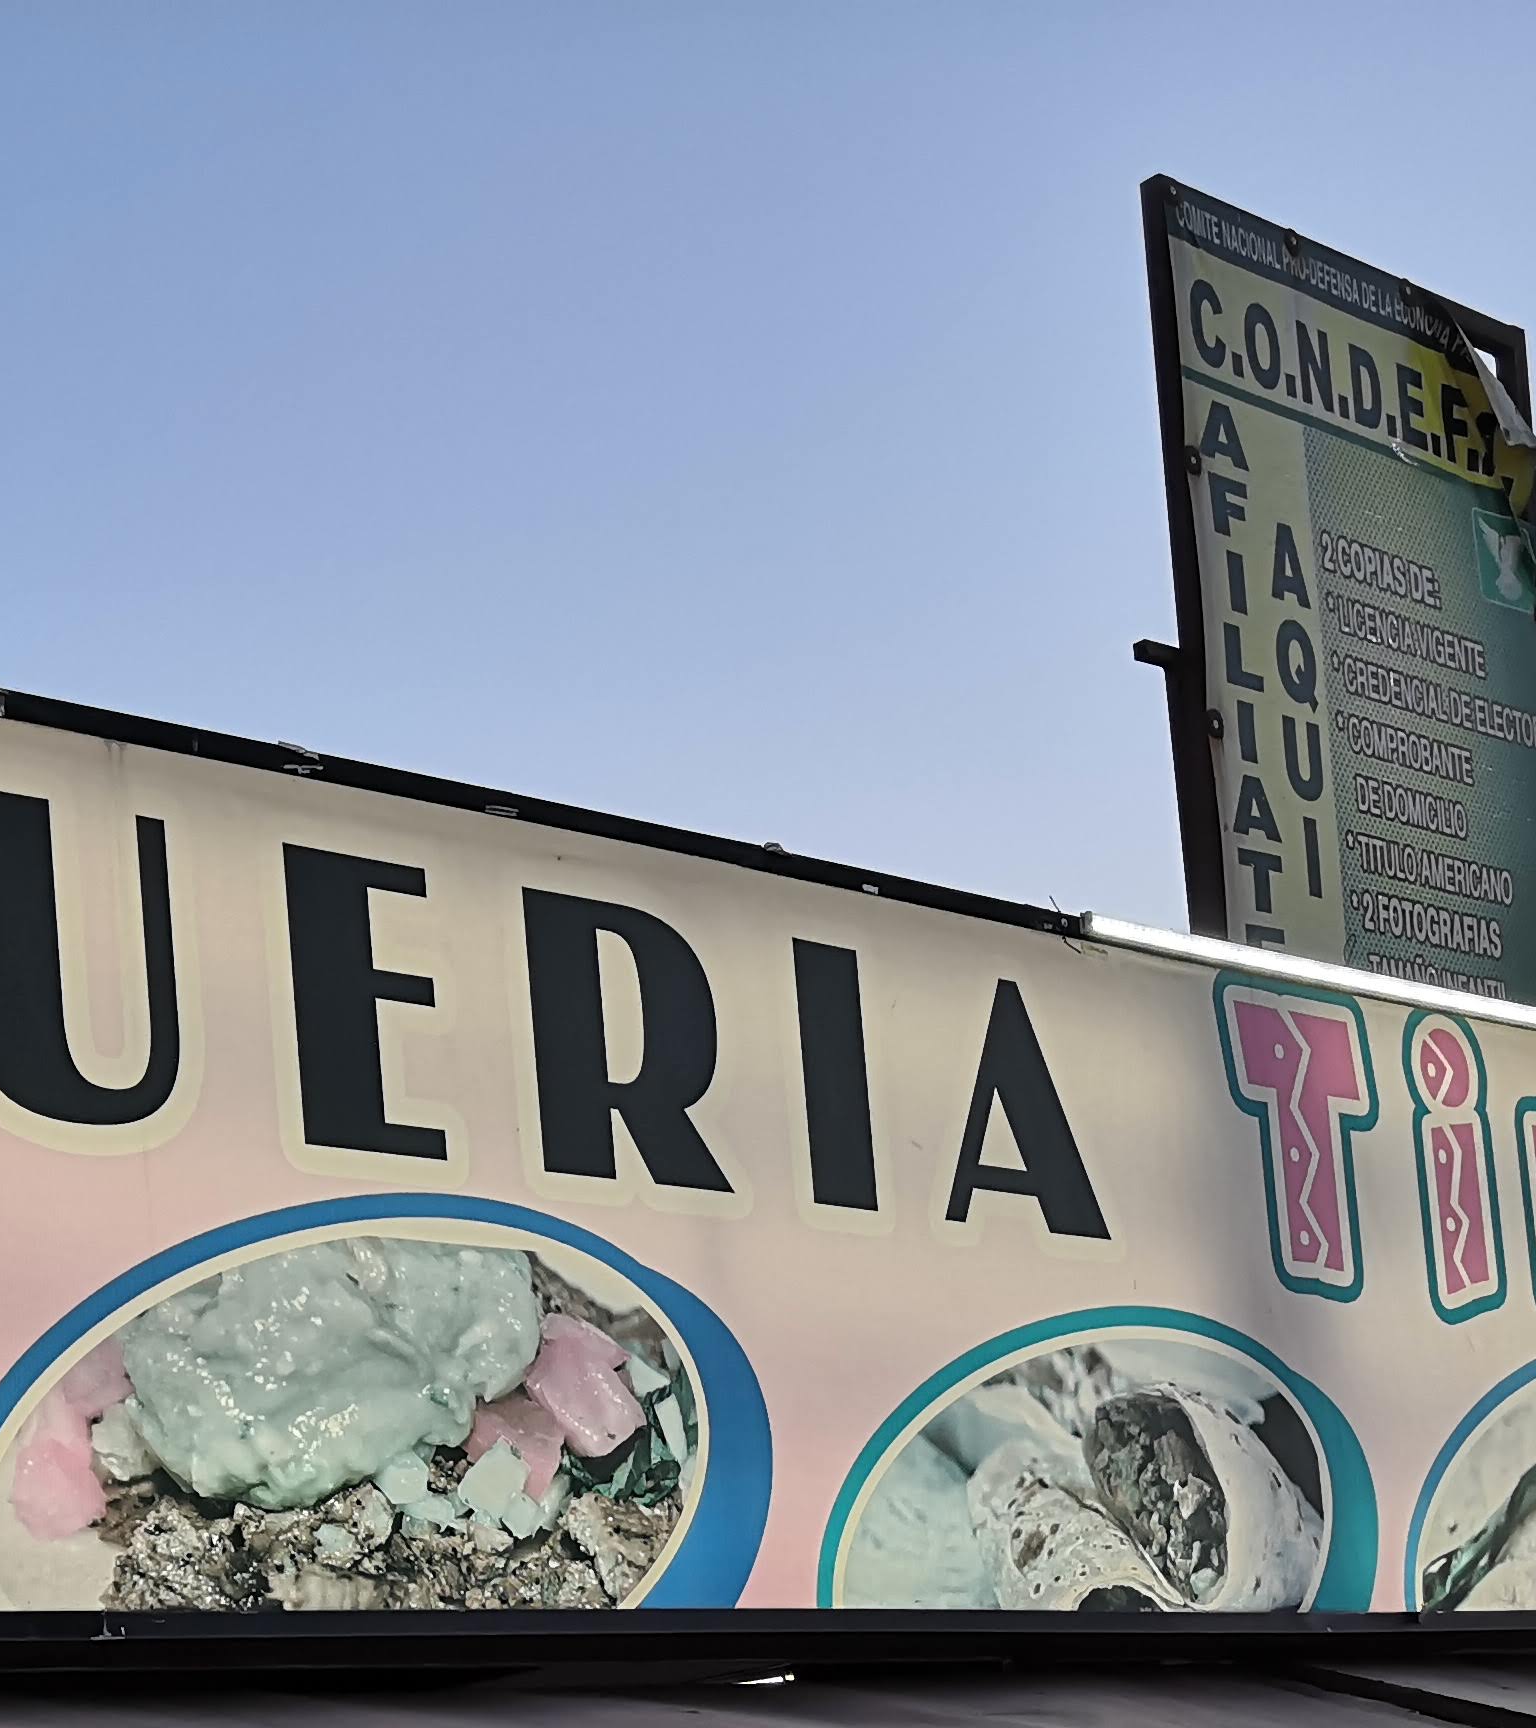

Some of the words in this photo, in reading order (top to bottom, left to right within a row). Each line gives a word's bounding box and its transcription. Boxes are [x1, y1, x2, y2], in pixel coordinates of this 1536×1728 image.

[1175, 200, 1221, 246] COMITE
[1221, 219, 1282, 271] NACIONAL
[1282, 243, 1361, 306] PRO-DEFENSA
[1361, 280, 1377, 314] DE
[1377, 287, 1393, 320] LA
[1320, 531, 1336, 572] 2
[1336, 536, 1407, 597] COPIAS
[1408, 560, 1441, 610] DE:
[1337, 597, 1413, 656] LICENCIA
[1412, 622, 1486, 678] VIGENTE
[1271, 523, 1324, 899] AQUI
[1344, 656, 1448, 723] CREDENCIAL
[1448, 690, 1473, 728] DE
[1348, 715, 1474, 785] COMPROBANTE
[1355, 775, 1382, 816] DE
[1382, 782, 1466, 839] DOMICILIO
[1357, 834, 1416, 883] TITULO
[1420, 851, 1513, 906] AMERICANO
[1362, 891, 1376, 931] 2
[1377, 894, 1503, 959] FOTOGRAFIAS
